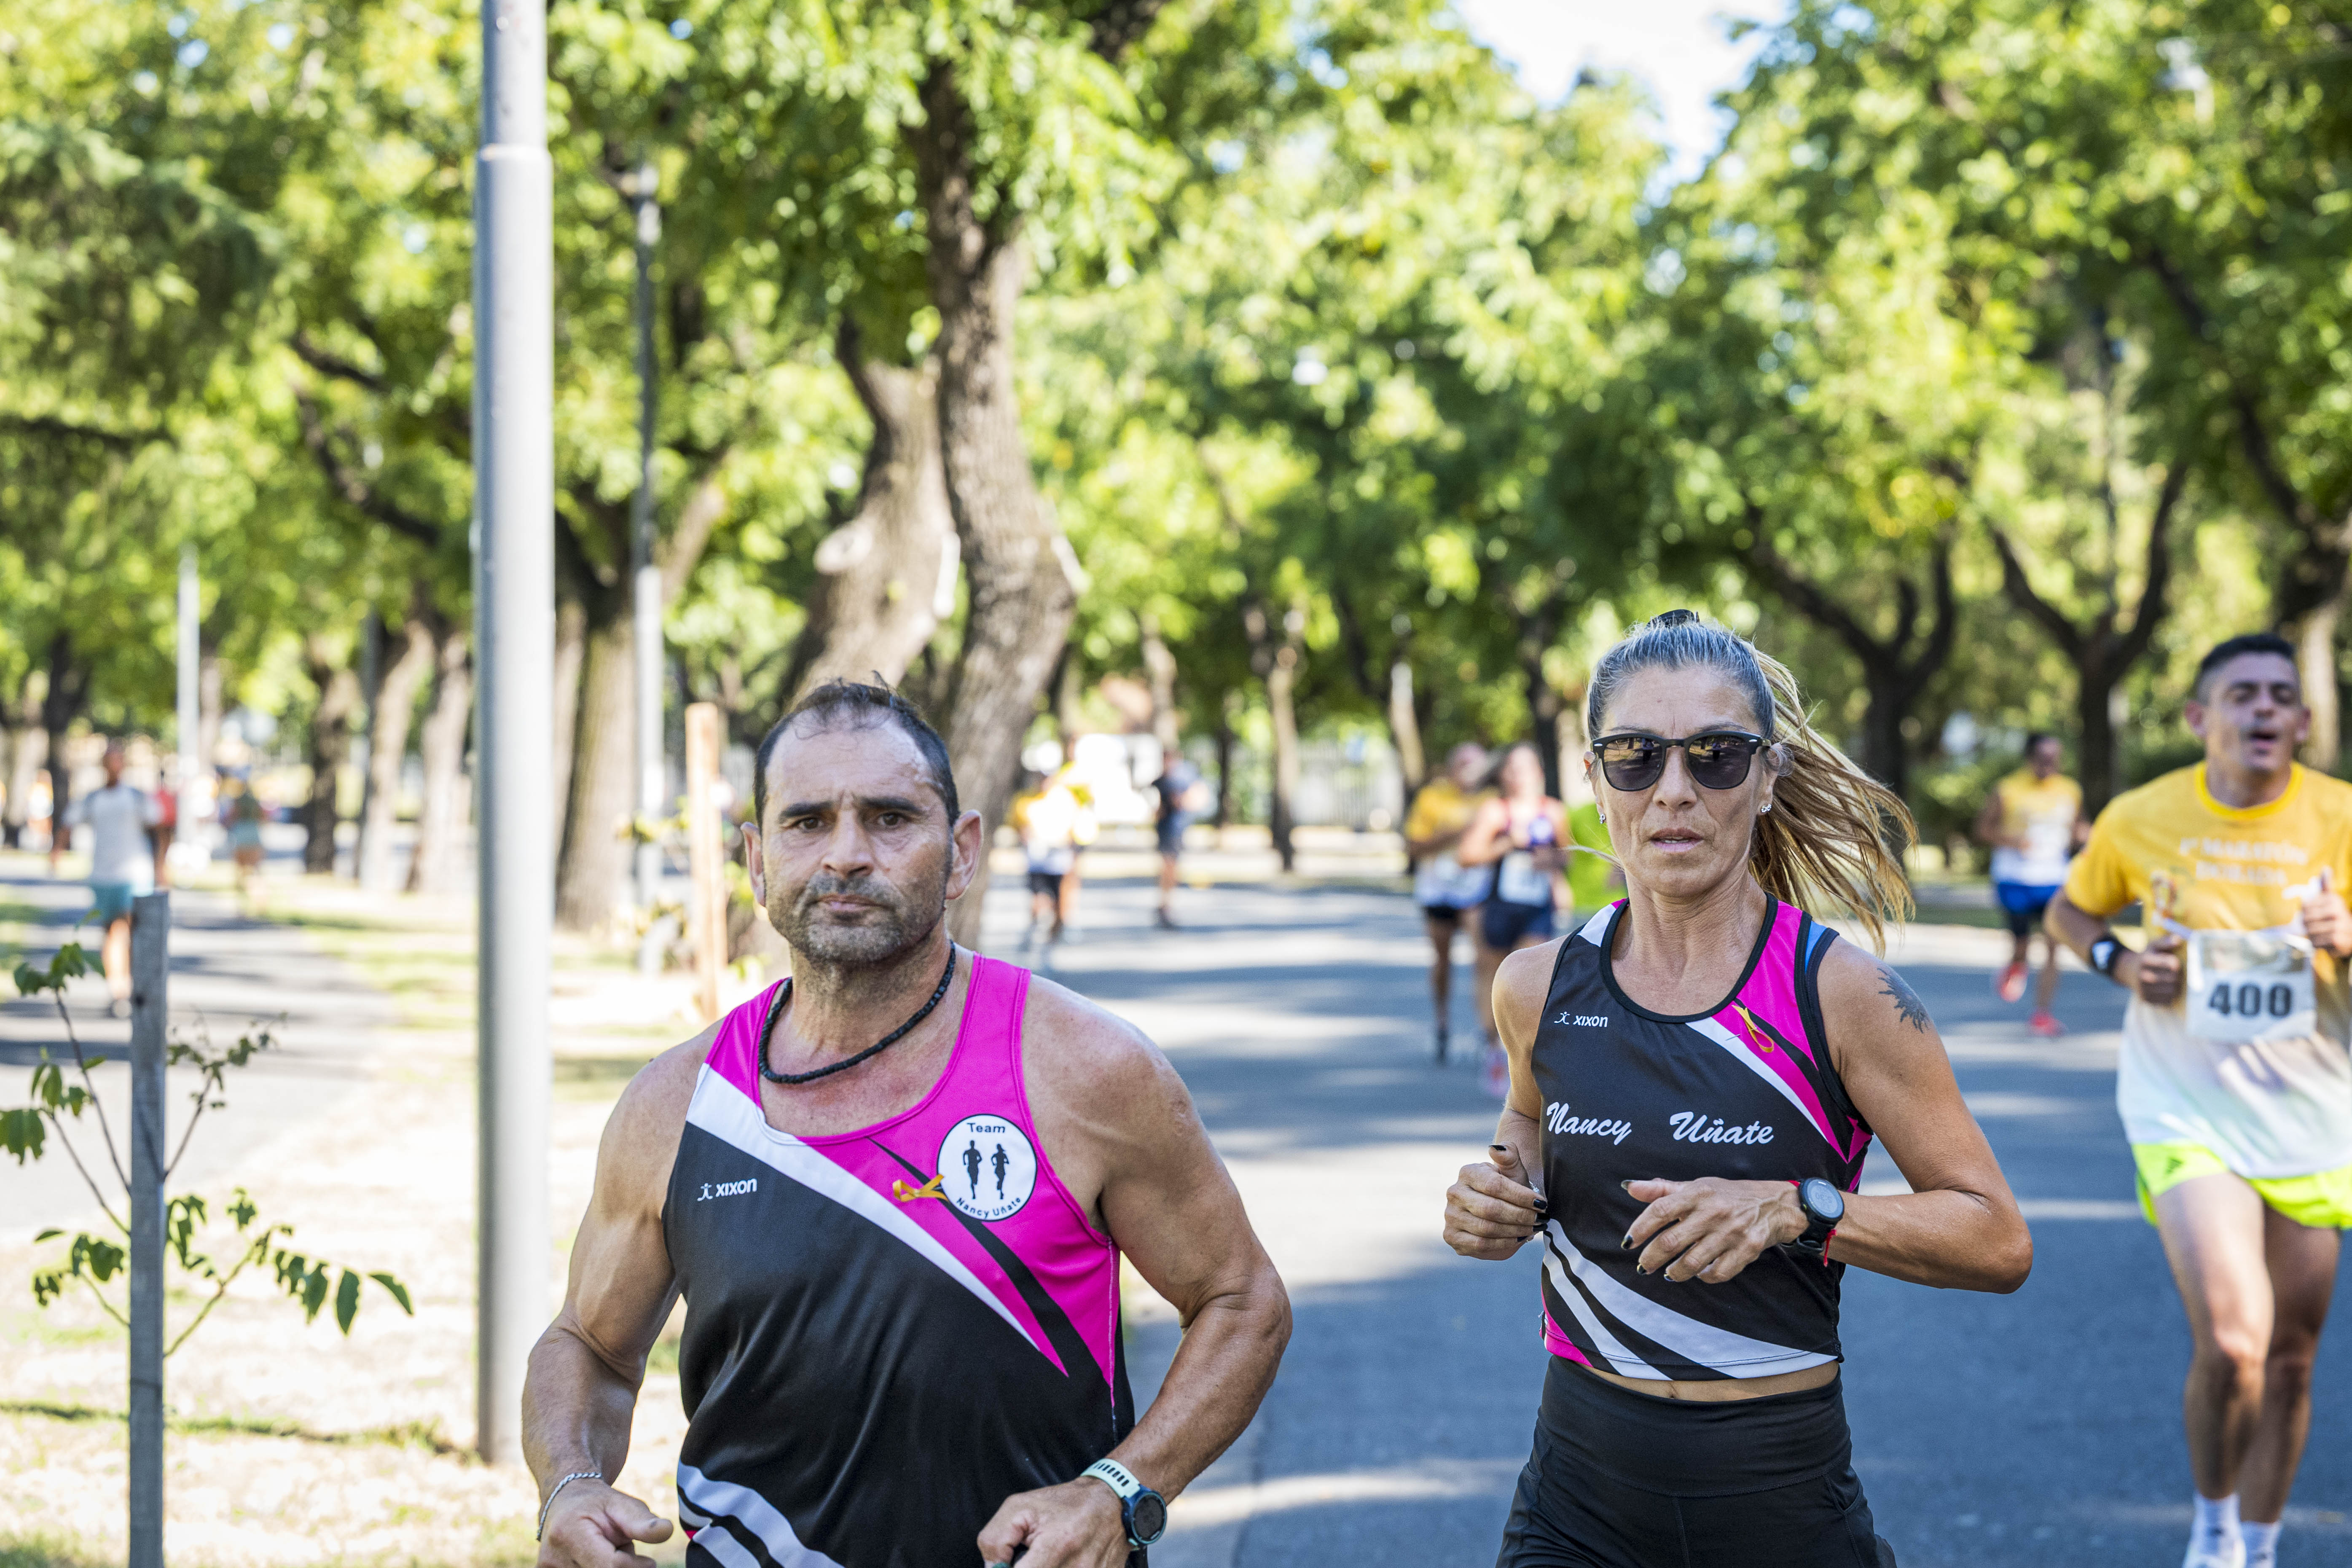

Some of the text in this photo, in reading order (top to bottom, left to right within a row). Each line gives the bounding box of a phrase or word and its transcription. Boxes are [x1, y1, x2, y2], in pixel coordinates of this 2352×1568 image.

[2207, 982, 2293, 1018] 400
[967, 1122, 1006, 1133] Team
[1546, 1101, 1775, 1146] Nancy Uñate
[956, 1197, 1021, 1219] Nancy Uñate
